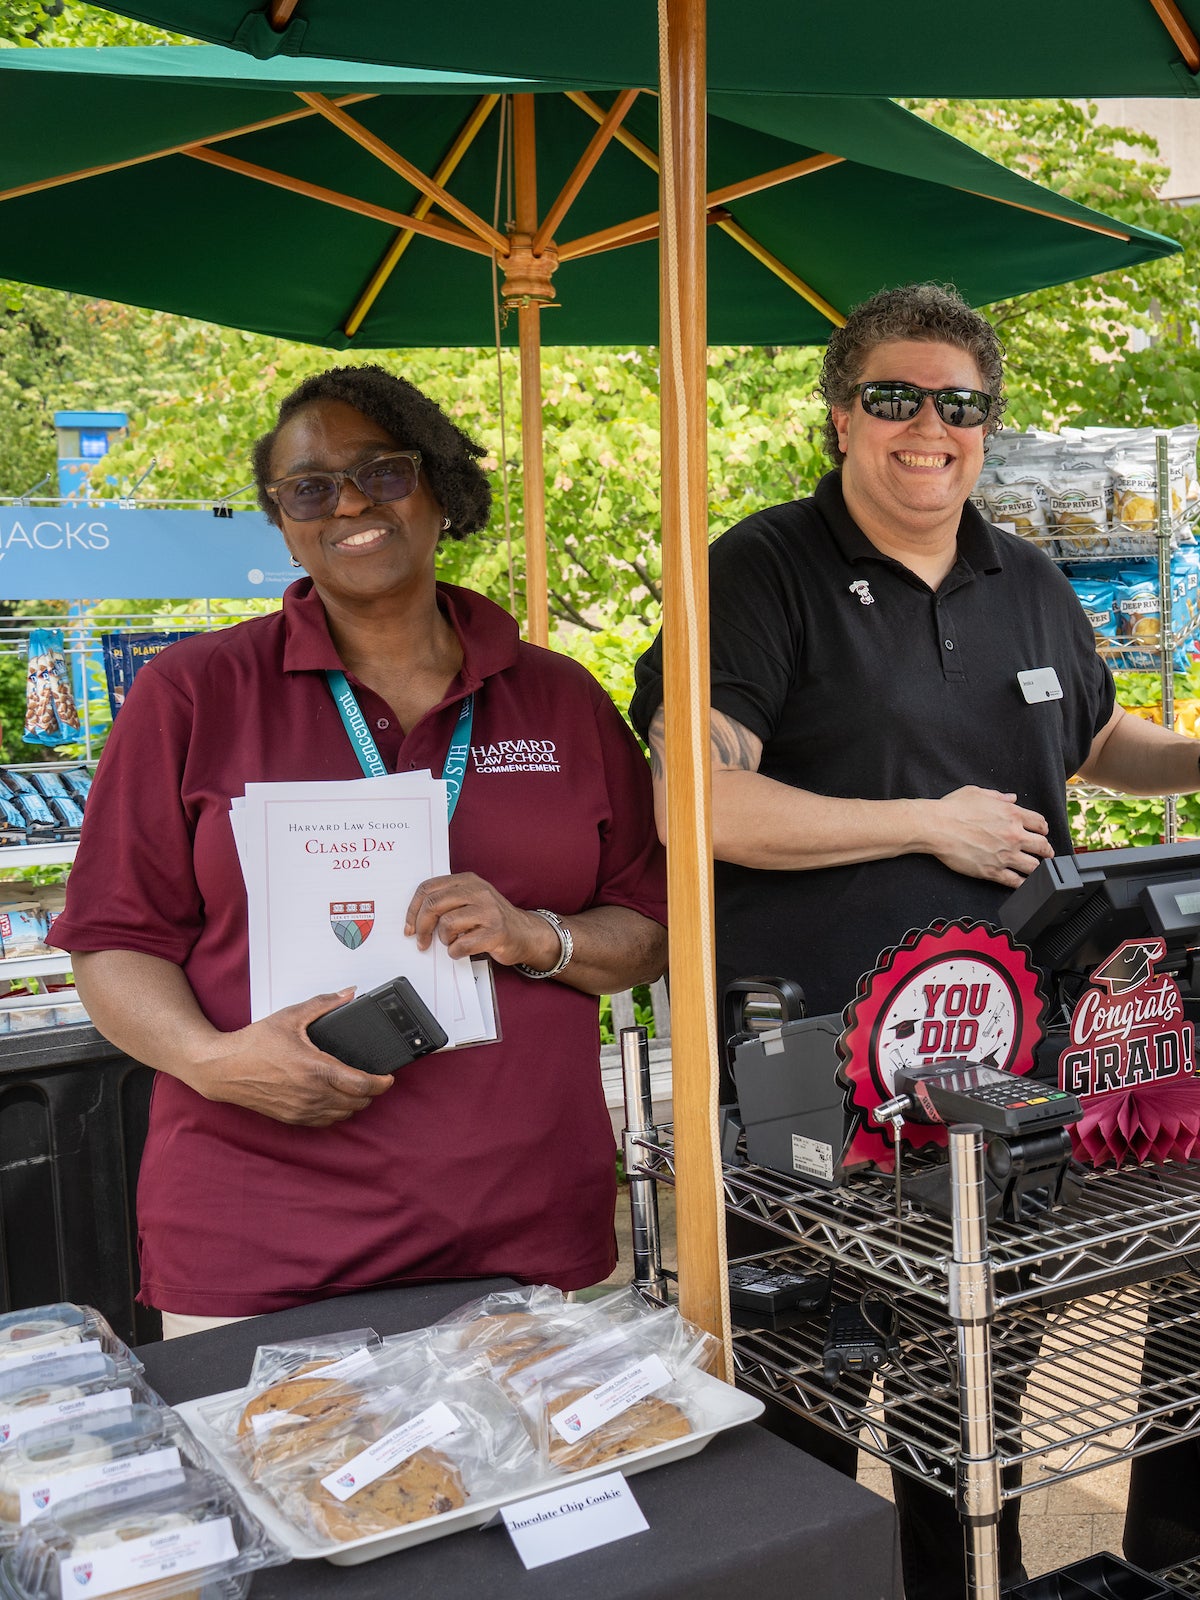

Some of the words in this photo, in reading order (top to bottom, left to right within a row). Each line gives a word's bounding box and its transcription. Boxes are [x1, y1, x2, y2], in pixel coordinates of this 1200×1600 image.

[1008, 501, 1033, 510] RIVER
[1052, 501, 1071, 509] DEEP
[1073, 499, 1099, 508] RIVER
[0, 521, 110, 550] ACKS
[1122, 602, 1141, 610] DEEP
[339, 691, 386, 777] mencement
[471, 739, 556, 758] HARVARD
[446, 743, 468, 776] HLS
[474, 756, 502, 767] LAW
[506, 751, 559, 763] SCHOOL
[476, 763, 561, 774] COMMENCEMENT
[289, 823, 340, 832] HARVARD
[344, 822, 365, 830] LAW
[368, 821, 410, 830] SCHOOL
[305, 839, 357, 854] CLASS
[363, 838, 395, 852] DAY
[332, 856, 370, 870] 2026
[922, 983, 990, 1018] YOU
[1073, 980, 1181, 1045] Congrats
[918, 1019, 980, 1055] DID
[1063, 1027, 1194, 1094] GRAD!
[560, 1501, 584, 1513] Chip
[586, 1489, 622, 1506] Cookie
